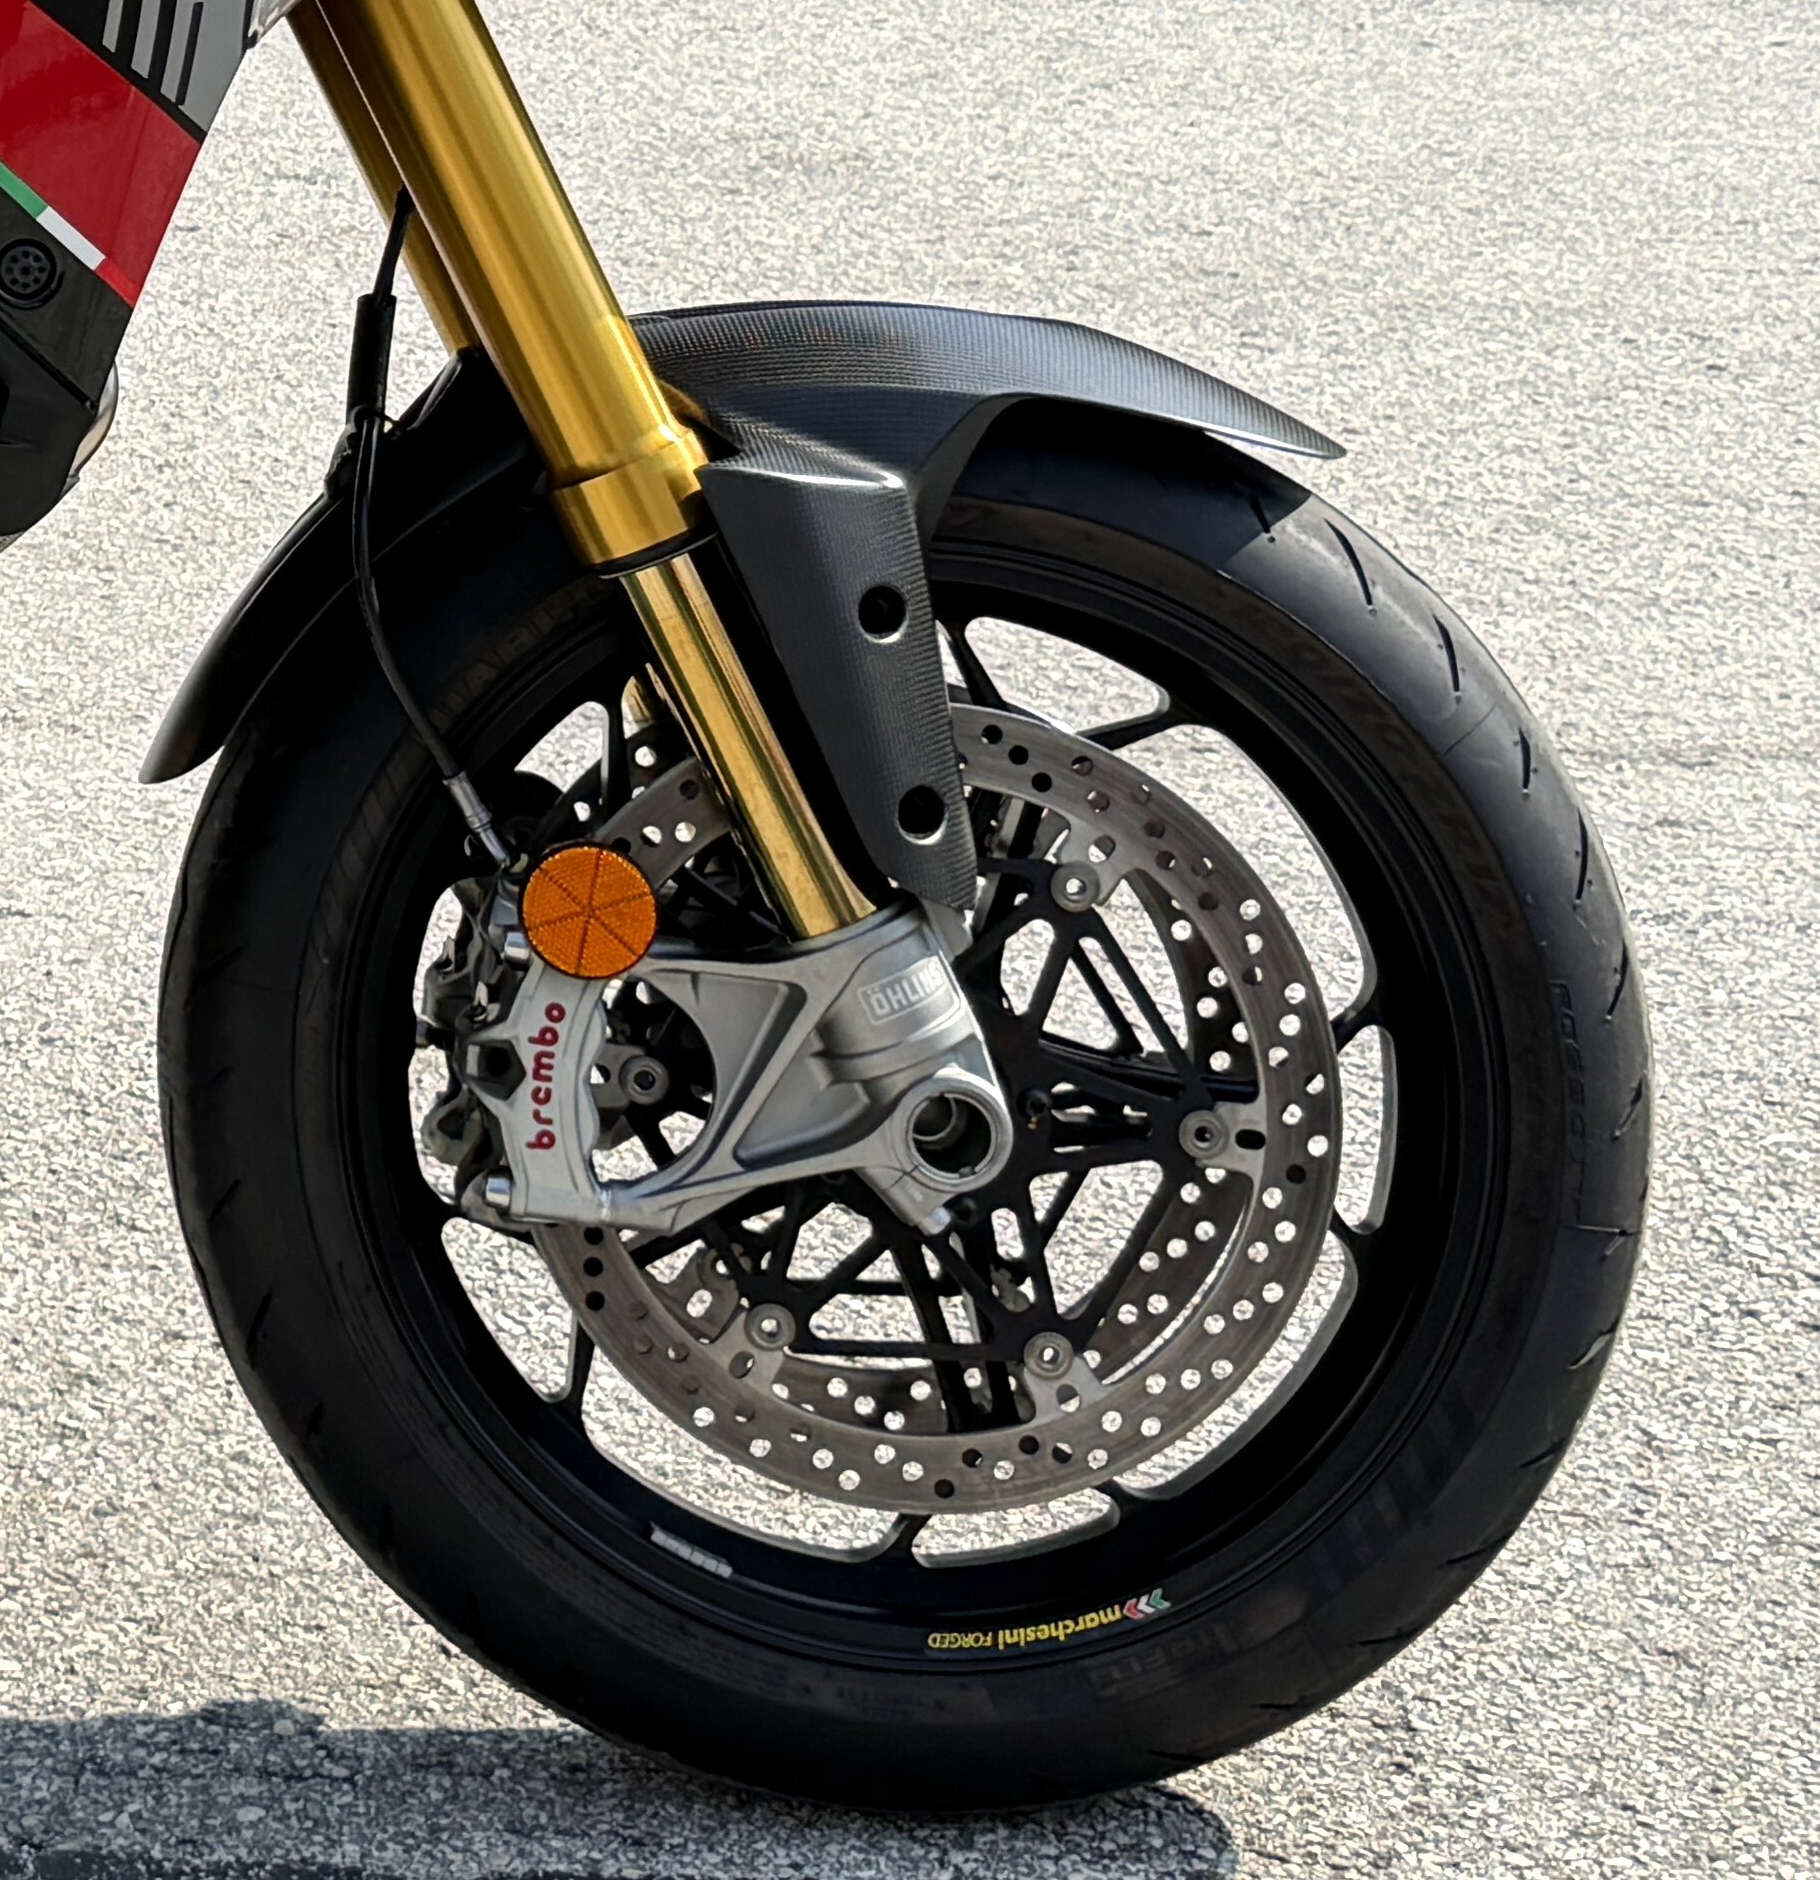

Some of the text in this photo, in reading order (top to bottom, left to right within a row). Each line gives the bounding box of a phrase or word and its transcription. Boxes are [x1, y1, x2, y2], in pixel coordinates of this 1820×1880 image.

[525, 1001, 567, 1151] brembo
[926, 1604, 1122, 1651] marchesini FORGED
